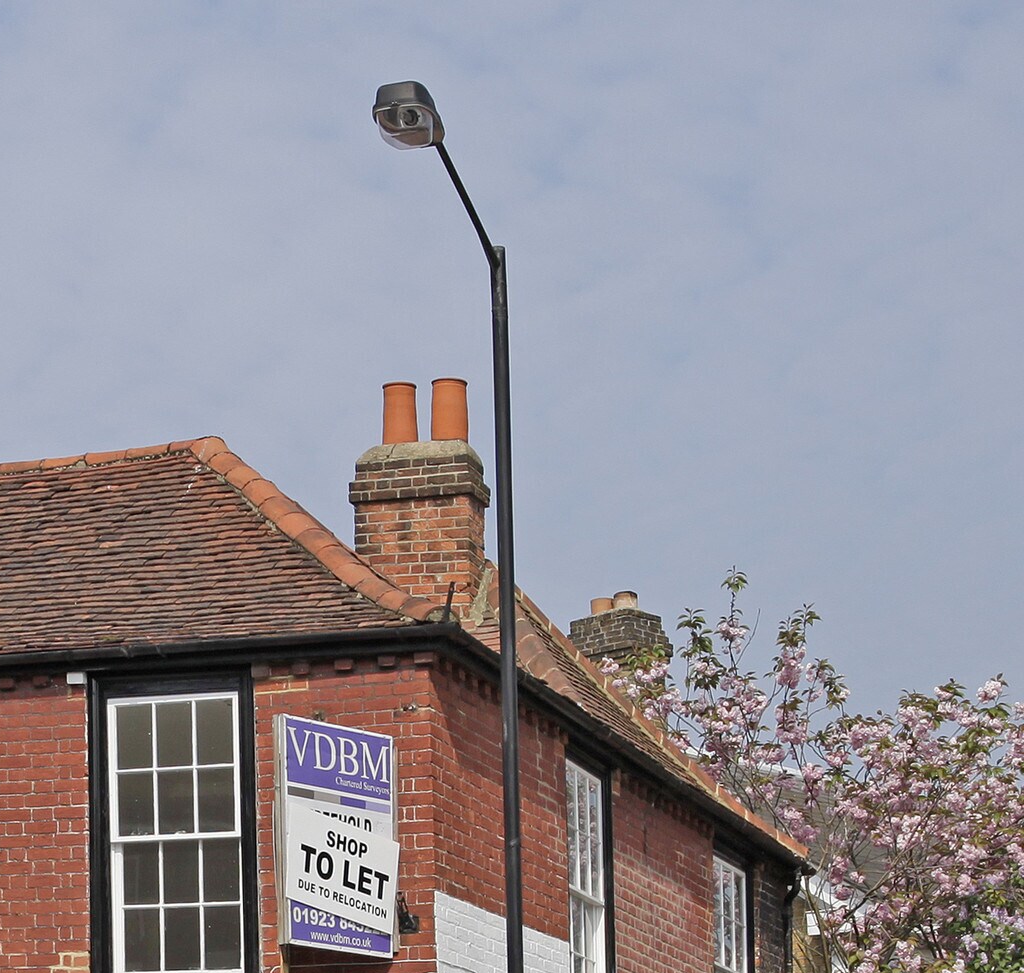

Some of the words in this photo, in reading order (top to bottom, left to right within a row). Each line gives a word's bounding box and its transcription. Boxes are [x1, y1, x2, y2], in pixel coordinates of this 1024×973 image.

[287, 726, 390, 783] VDBM
[335, 776, 363, 790] Chartered
[363, 782, 390, 796] Surveyors
[326, 830, 368, 858] SHOP
[300, 843, 334, 881] TO
[342, 859, 390, 900] LET
[298, 878, 316, 894] DUE
[318, 885, 330, 899] TO
[332, 891, 388, 919] RELOCATION
[292, 906, 336, 928] 01923
[310, 931, 372, 948] www.vdbm.co.uk
